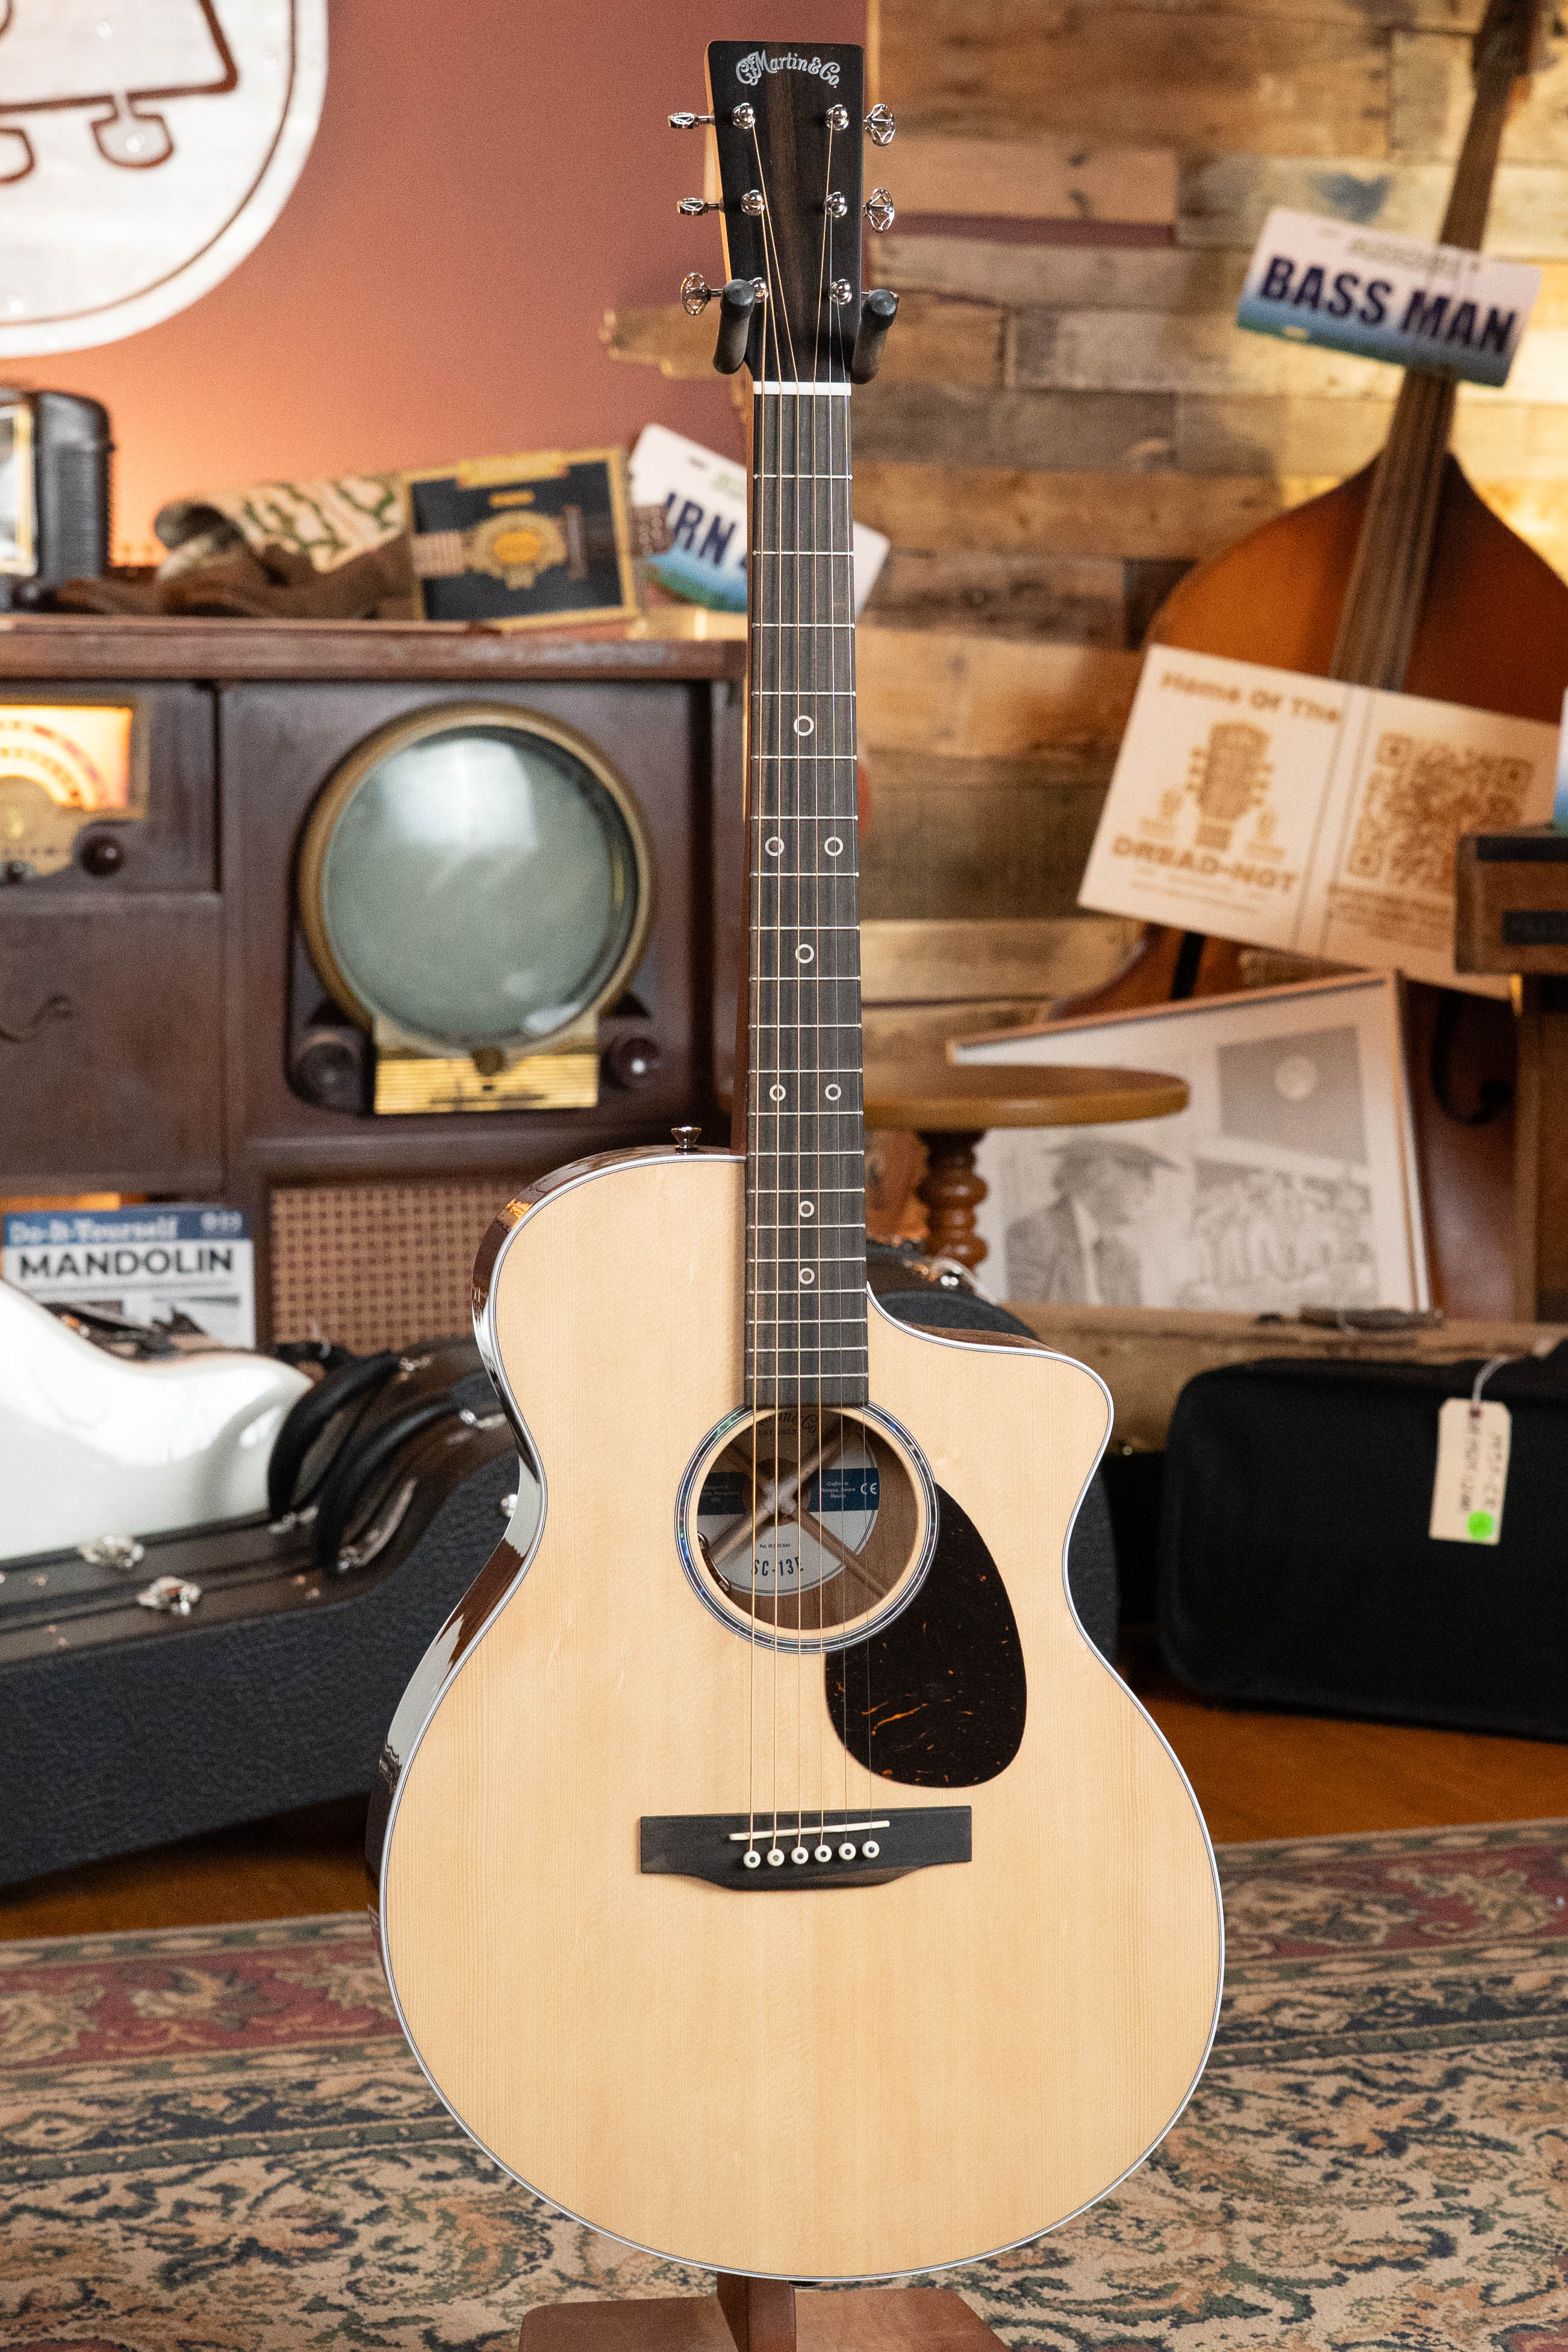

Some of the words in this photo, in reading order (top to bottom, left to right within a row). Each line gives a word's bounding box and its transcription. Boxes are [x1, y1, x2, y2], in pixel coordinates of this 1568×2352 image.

[1260, 255, 1392, 327] BASS
[1398, 288, 1517, 354] MAN
[664, 492, 736, 567] RN
[19, 1248, 234, 1279] MANDOLIN
